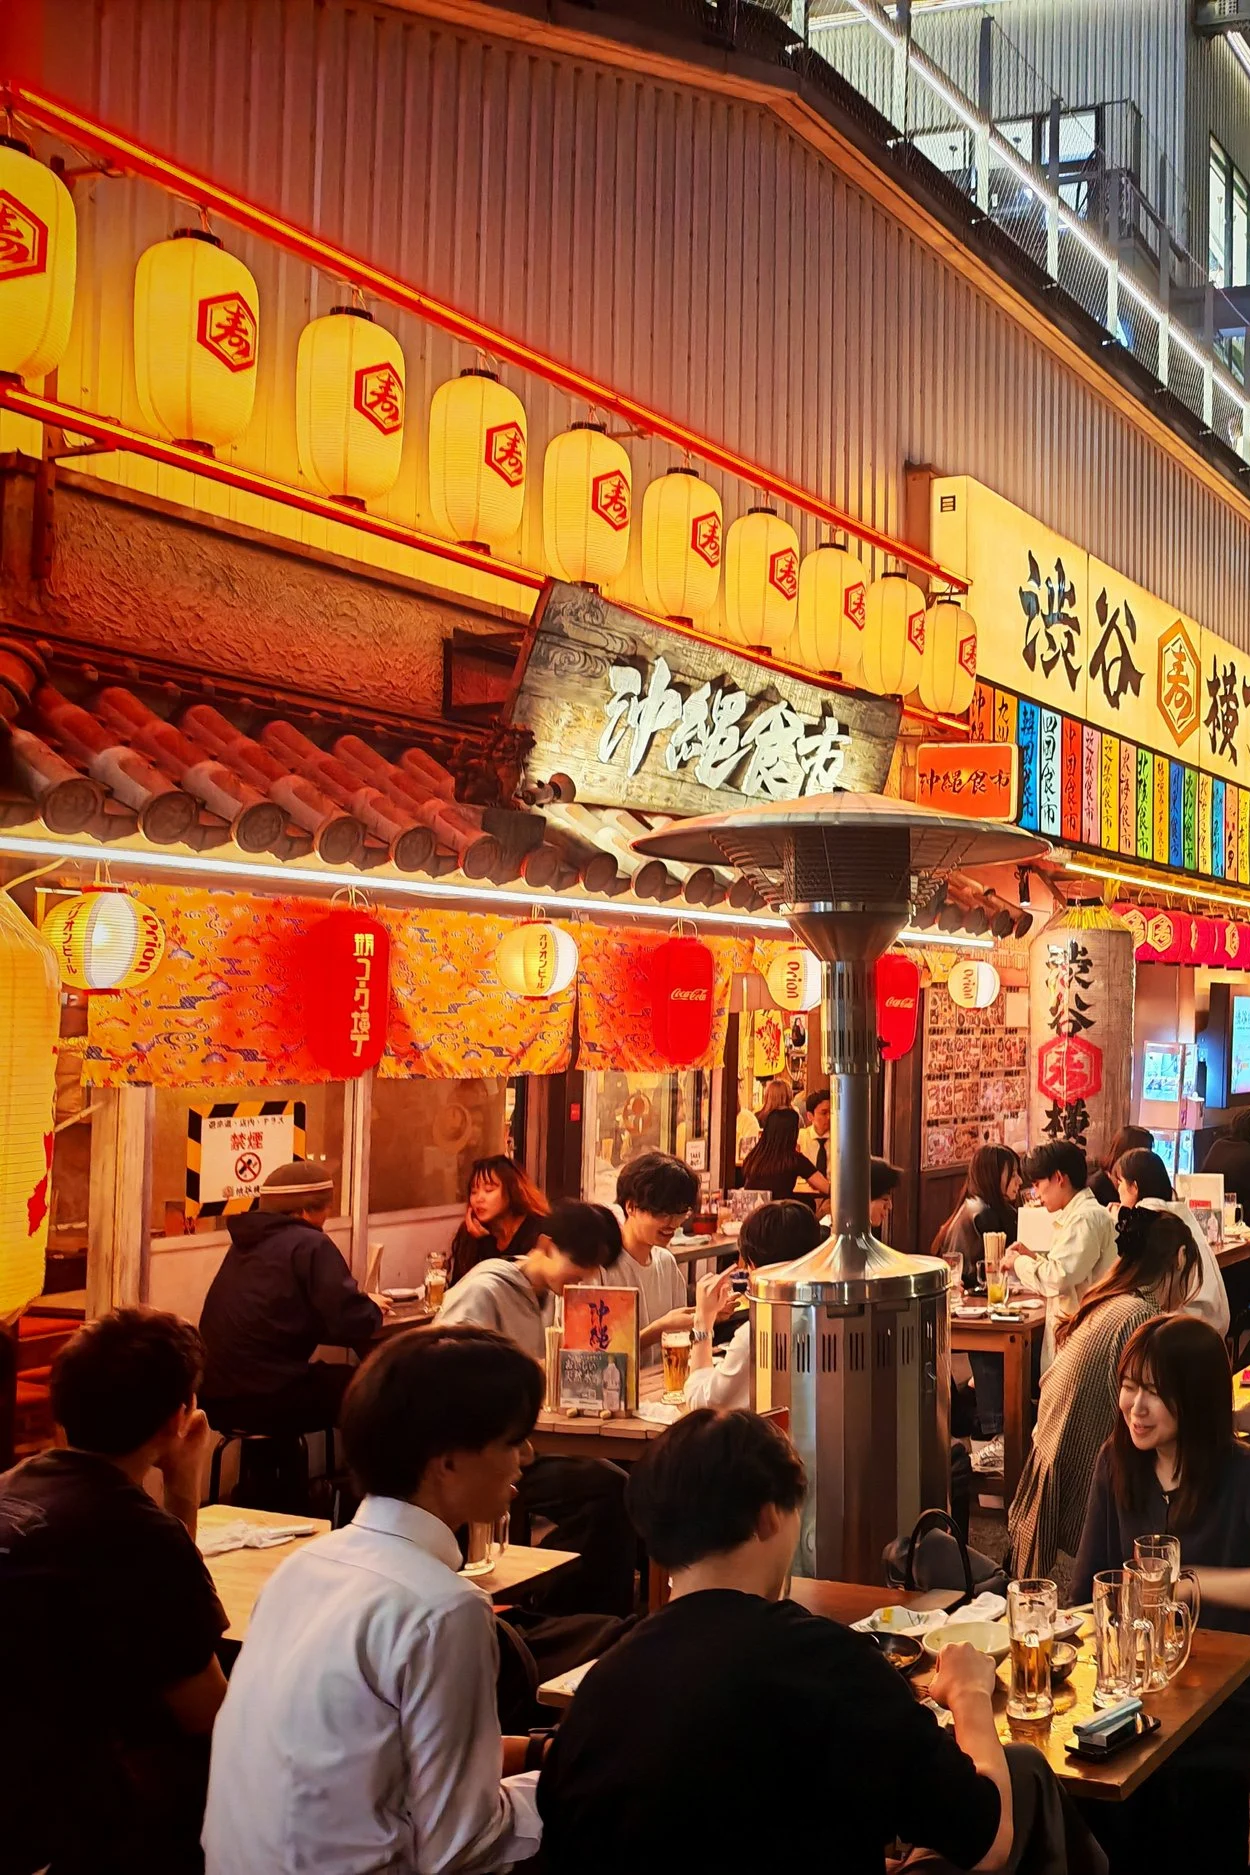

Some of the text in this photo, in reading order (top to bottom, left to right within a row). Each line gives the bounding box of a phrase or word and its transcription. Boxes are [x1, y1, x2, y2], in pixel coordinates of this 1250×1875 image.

[919, 768, 1010, 795] 沖縄食市
[1042, 716, 1058, 829] 四国食市
[1063, 721, 1079, 831] 中国食市
[63, 902, 86, 975] オリオンビール
[134, 915, 161, 973] Orion
[537, 934, 547, 988] オリオンビール
[786, 961, 802, 999] Orion
[963, 969, 973, 1000] Orion
[230, 1132, 263, 1151] 禁煙
